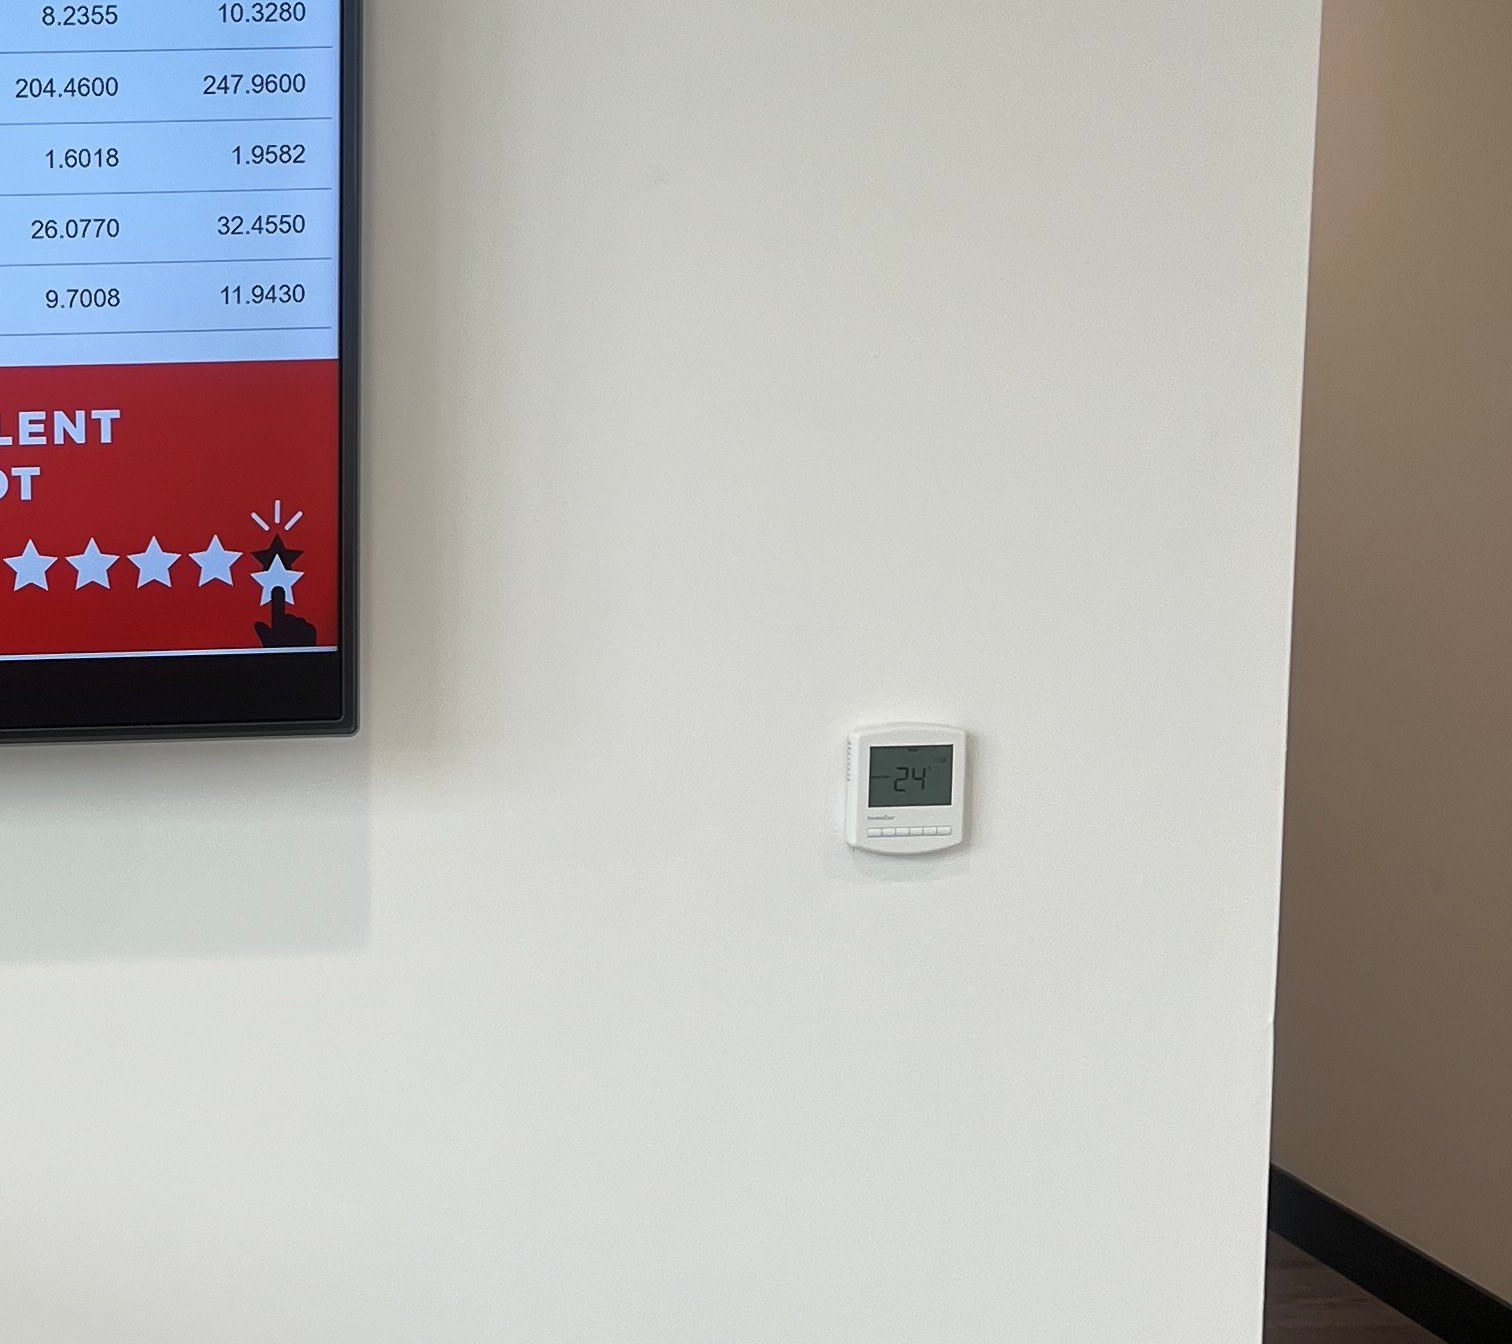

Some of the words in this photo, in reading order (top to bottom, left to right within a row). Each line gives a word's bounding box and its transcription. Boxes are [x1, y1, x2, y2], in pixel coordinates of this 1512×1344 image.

[42, 5, 117, 26] 8.2355
[219, 2, 305, 23] 10.3280
[16, 77, 118, 98] 204.4600
[203, 73, 305, 94] 247.9600
[46, 148, 119, 168] 1.6018
[233, 145, 305, 164] 1.9582
[32, 219, 119, 239] 26.0770
[218, 215, 305, 235] 32.4550
[46, 288, 120, 308] 9.7008
[221, 284, 305, 304] 11.9430
[894, 766, 926, 792] 24
